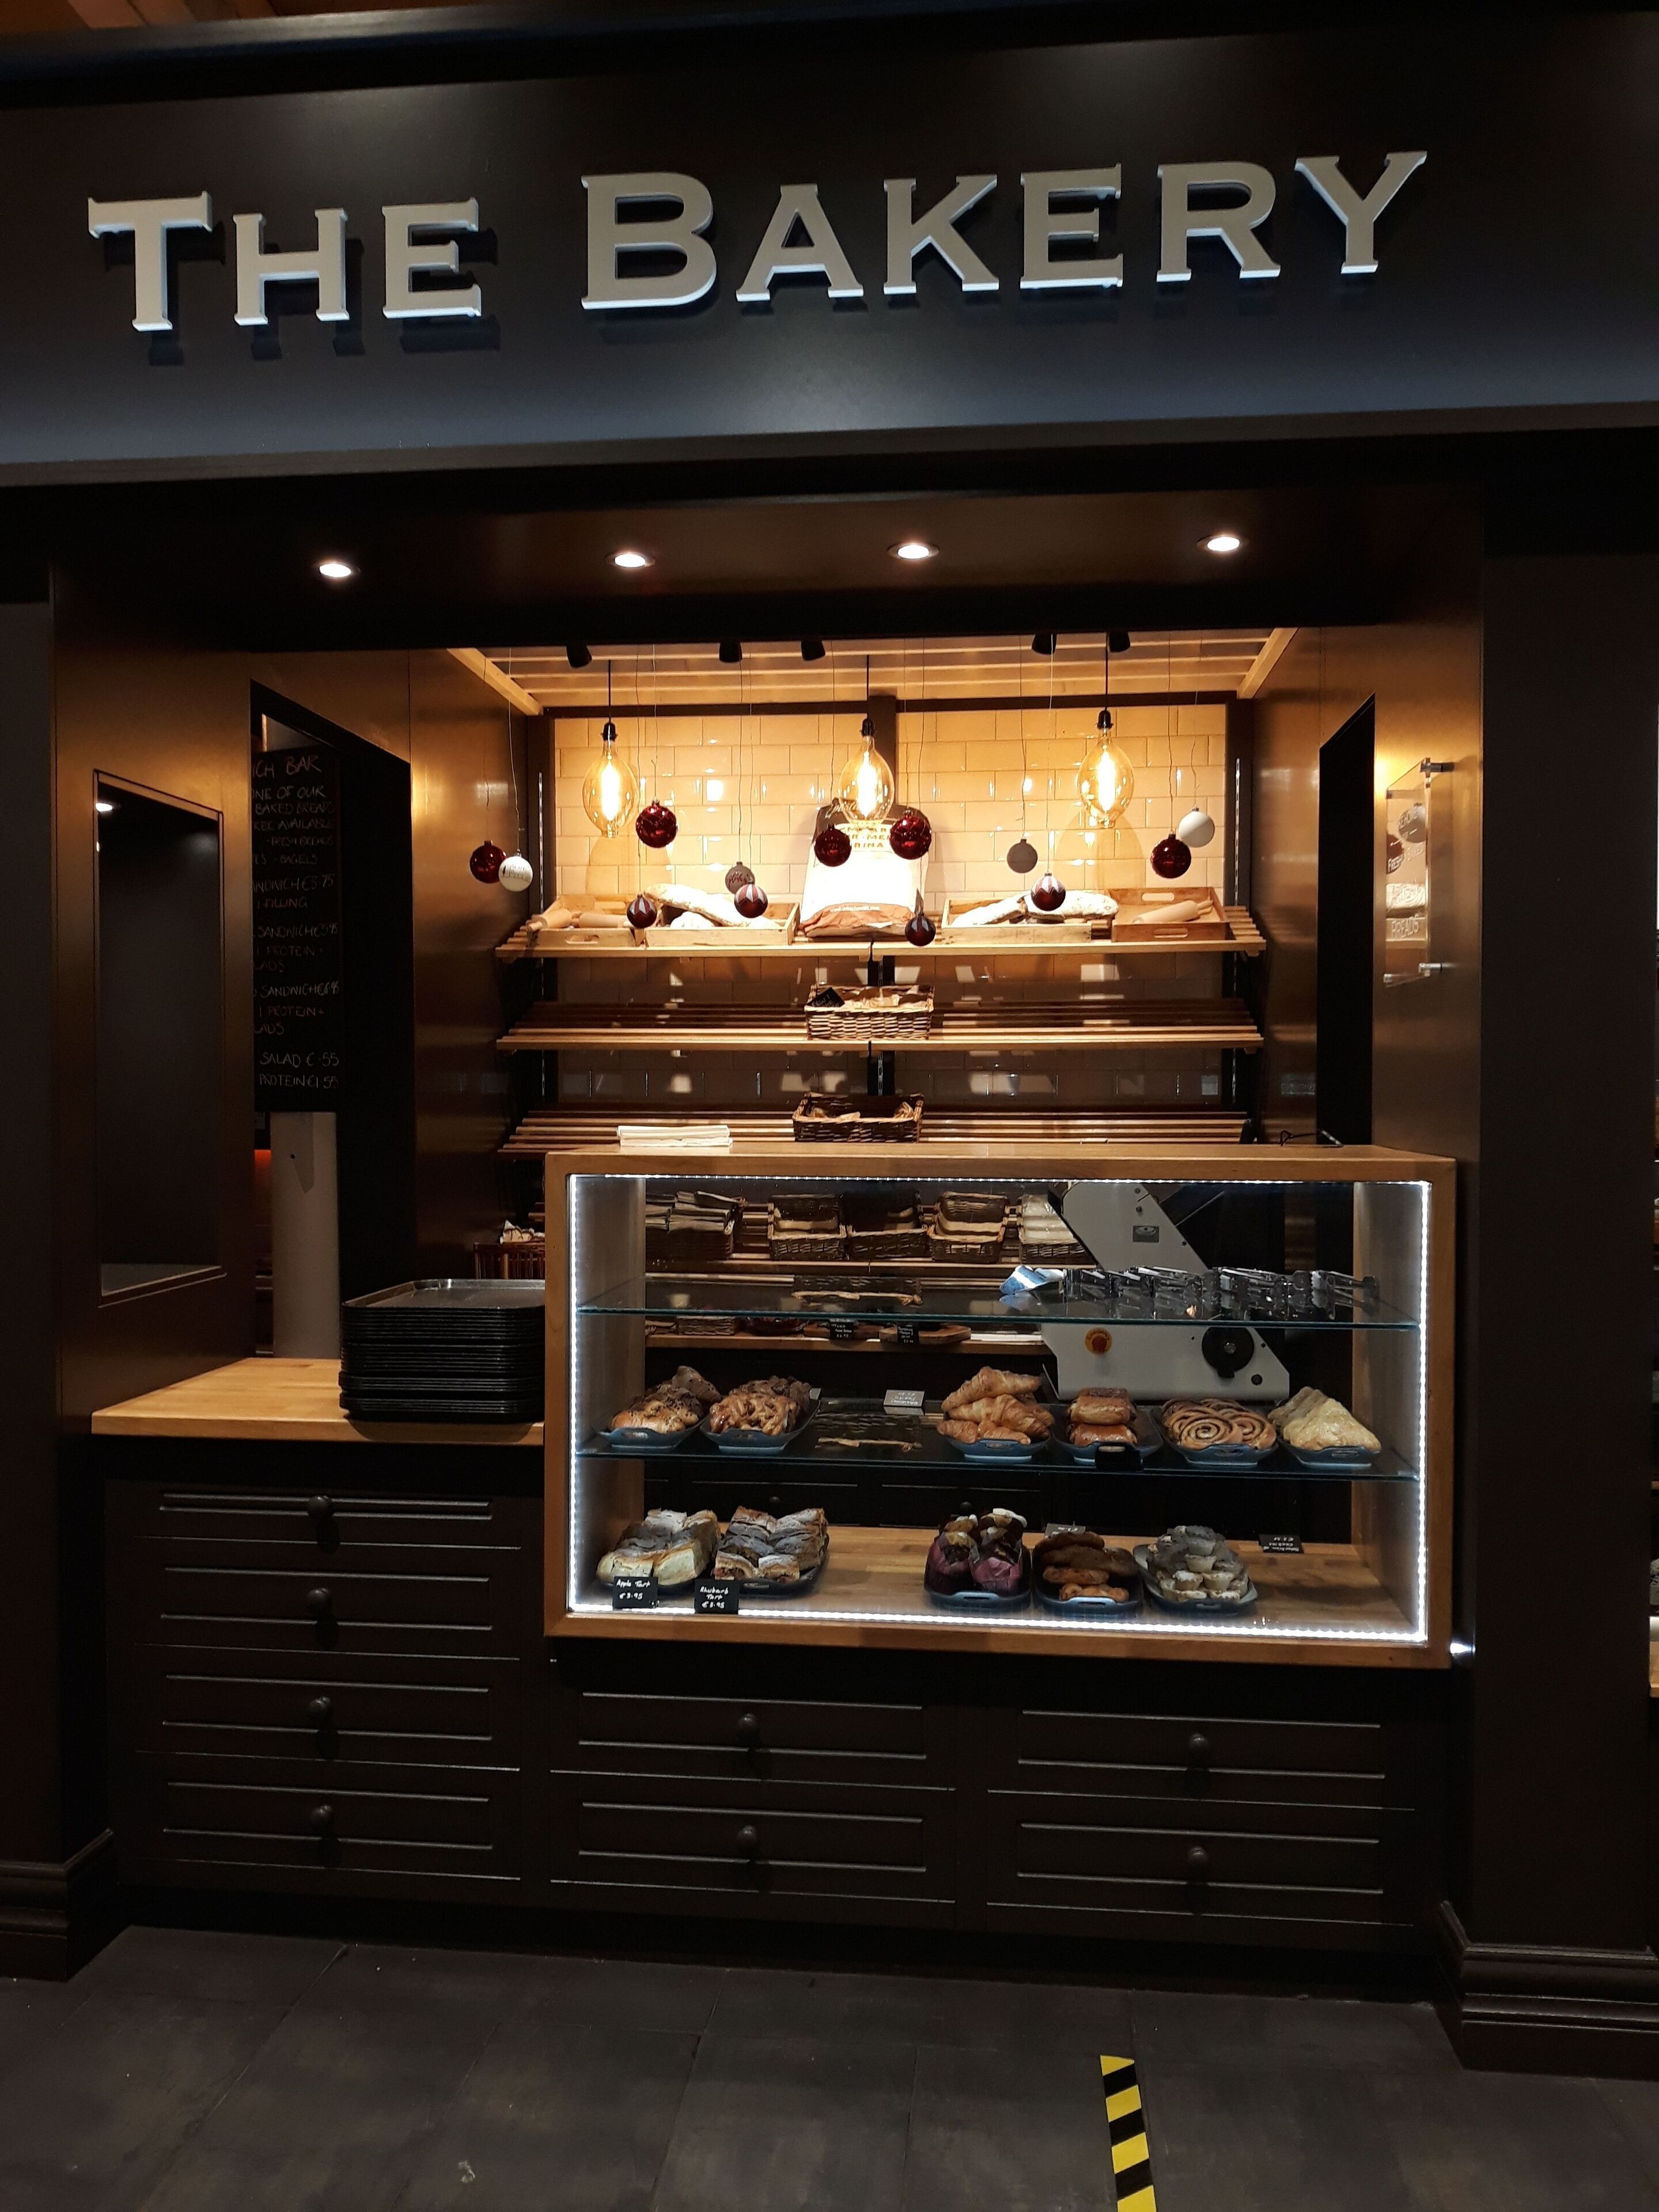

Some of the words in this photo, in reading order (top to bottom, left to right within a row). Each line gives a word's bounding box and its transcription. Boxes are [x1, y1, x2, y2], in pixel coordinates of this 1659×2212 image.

[88, 190, 482, 331] THE
[581, 151, 1427, 312] BAKERY
[285, 755, 321, 775] BAR
[276, 785, 295, 800] OF
[255, 802, 294, 816] BAKED
[263, 896, 309, 909] FILLING
[260, 983, 317, 998] SANDWICH
[267, 1005, 316, 1017] PROTEIN
[260, 1051, 301, 1069] SALAD
[259, 1073, 305, 1088] PROTEIN
[616, 1579, 632, 1588] Apple
[634, 1580, 651, 1588] Tart
[700, 1586, 729, 1595] Rhubarb
